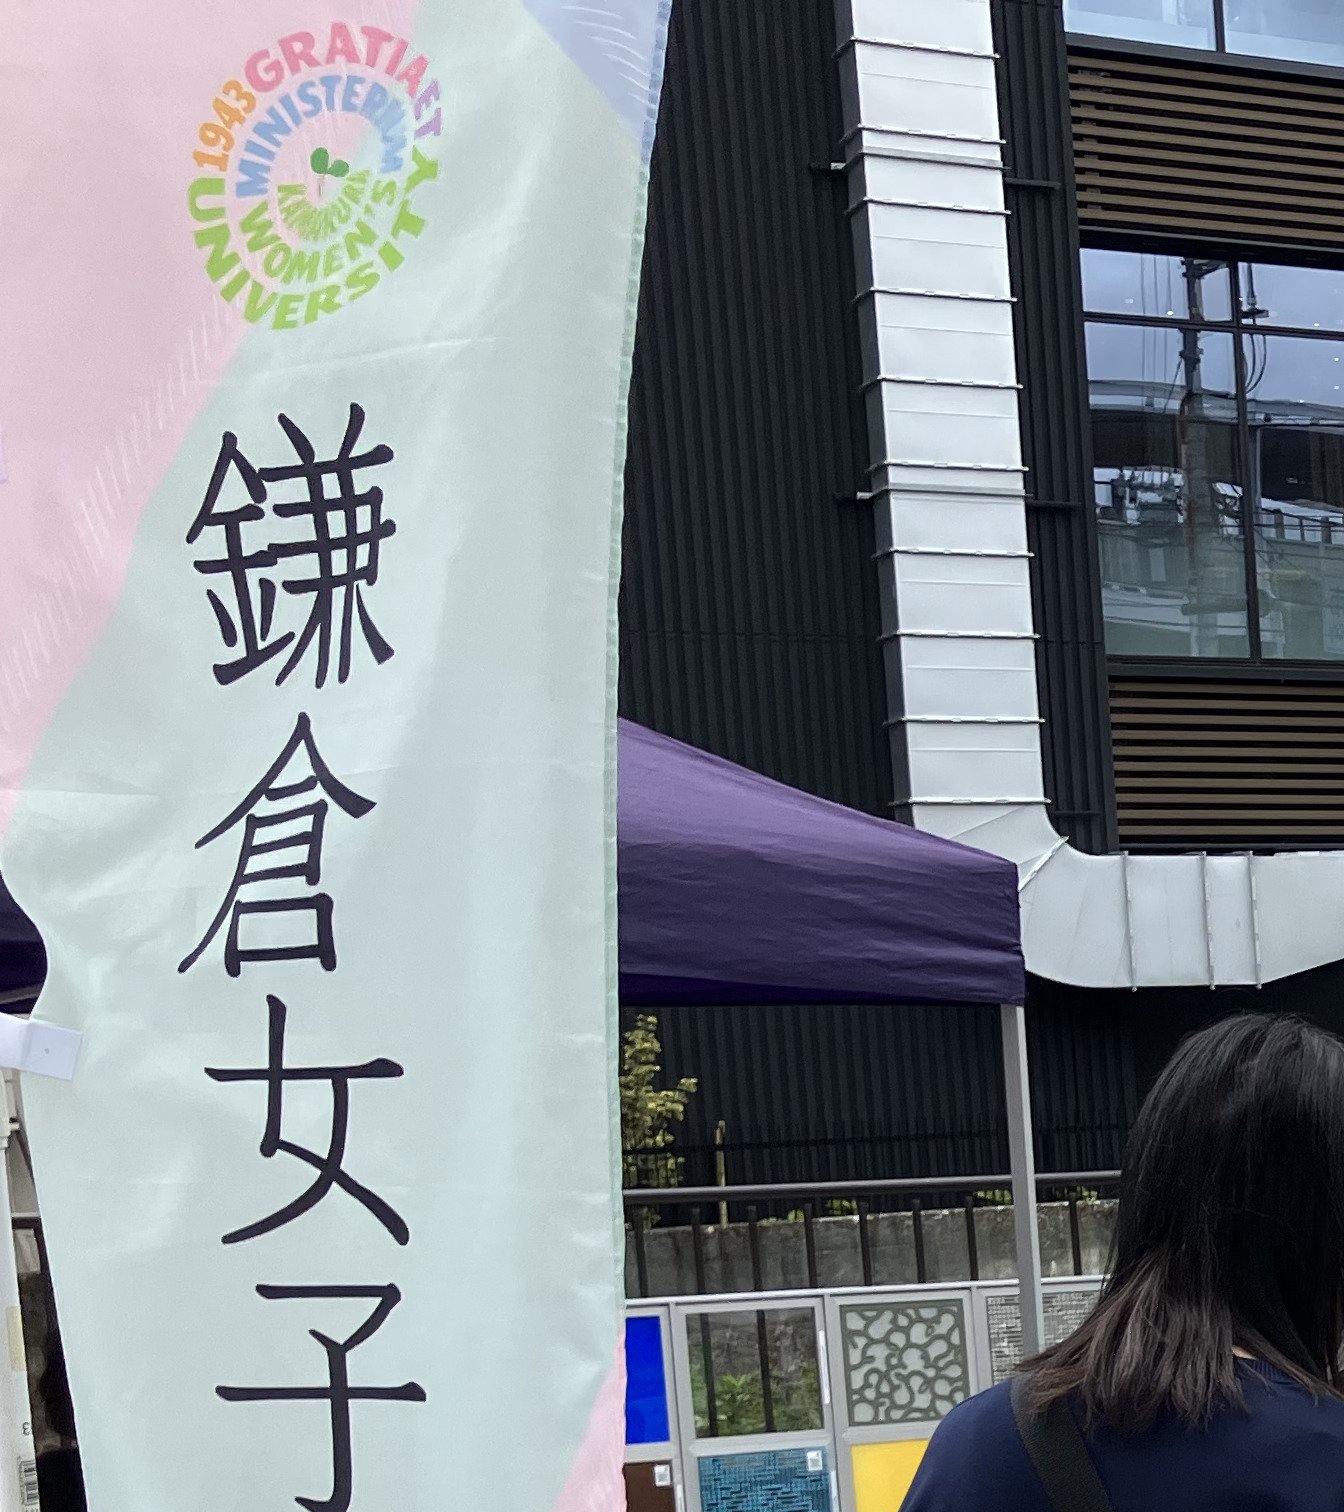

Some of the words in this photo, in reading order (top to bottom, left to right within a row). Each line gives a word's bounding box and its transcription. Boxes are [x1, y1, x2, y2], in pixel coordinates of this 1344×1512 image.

[244, 21, 429, 98] GRATIA
[193, 79, 257, 172] 1943
[186, 145, 439, 330] UNIVERSITY
[240, 179, 397, 285] WOMEN'S
